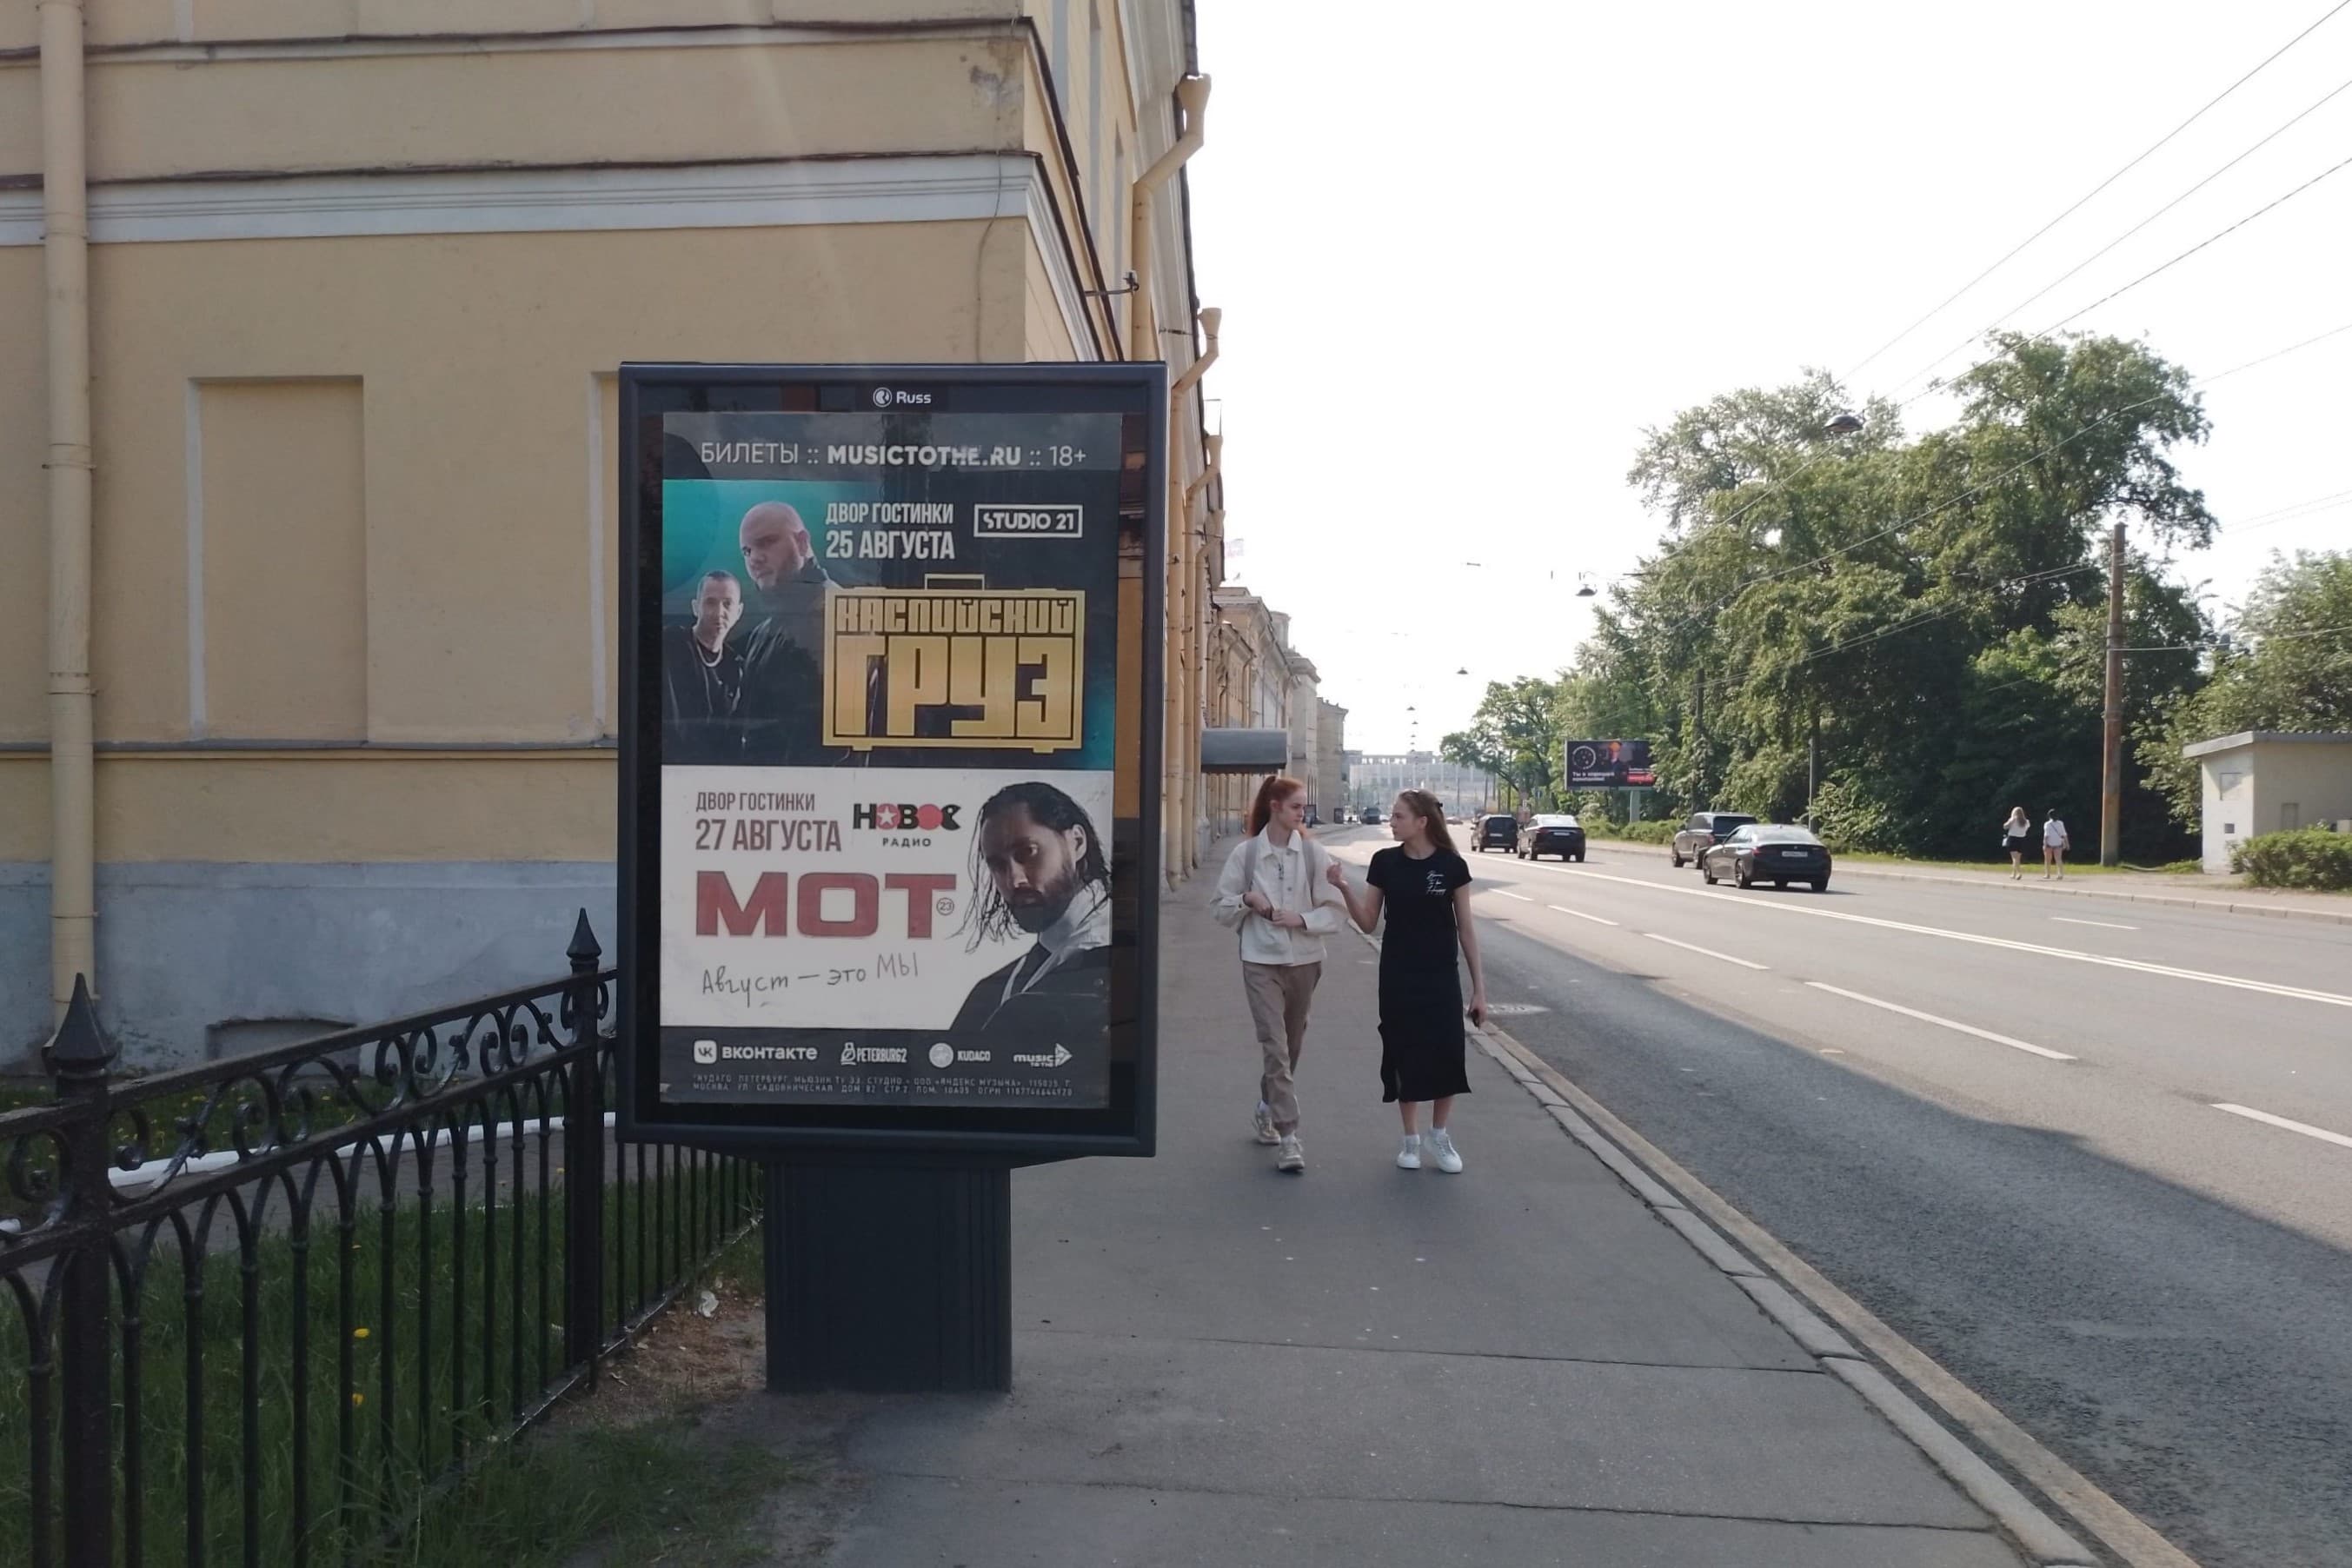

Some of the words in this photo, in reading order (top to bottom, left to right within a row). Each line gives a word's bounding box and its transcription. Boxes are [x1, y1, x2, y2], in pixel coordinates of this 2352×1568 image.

[896, 390, 932, 404] Russ
[701, 442, 799, 464] БИЛЕТЫ
[827, 444, 1021, 467] MUSICTOTHE.RU
[1049, 444, 1086, 467] 18+
[826, 502, 868, 525] ДВОР
[872, 502, 953, 525] ГОСТИНКИ
[983, 511, 1049, 531] STUDIO
[1055, 511, 1074, 531] 21
[826, 530, 853, 559] 25
[858, 530, 955, 561] АВГУСТА
[835, 597, 1076, 633] КАСПИЙСКИЙ
[834, 635, 1074, 738] ГРУЗ
[695, 792, 736, 812] ДВОР
[739, 792, 815, 812] ГОСТИНКИ
[695, 819, 727, 851] 27
[732, 819, 842, 852] АВГУСТА
[882, 837, 932, 848] РАДИО
[695, 870, 957, 940] МОТ
[702, 965, 789, 1008] Август
[827, 968, 867, 986] это
